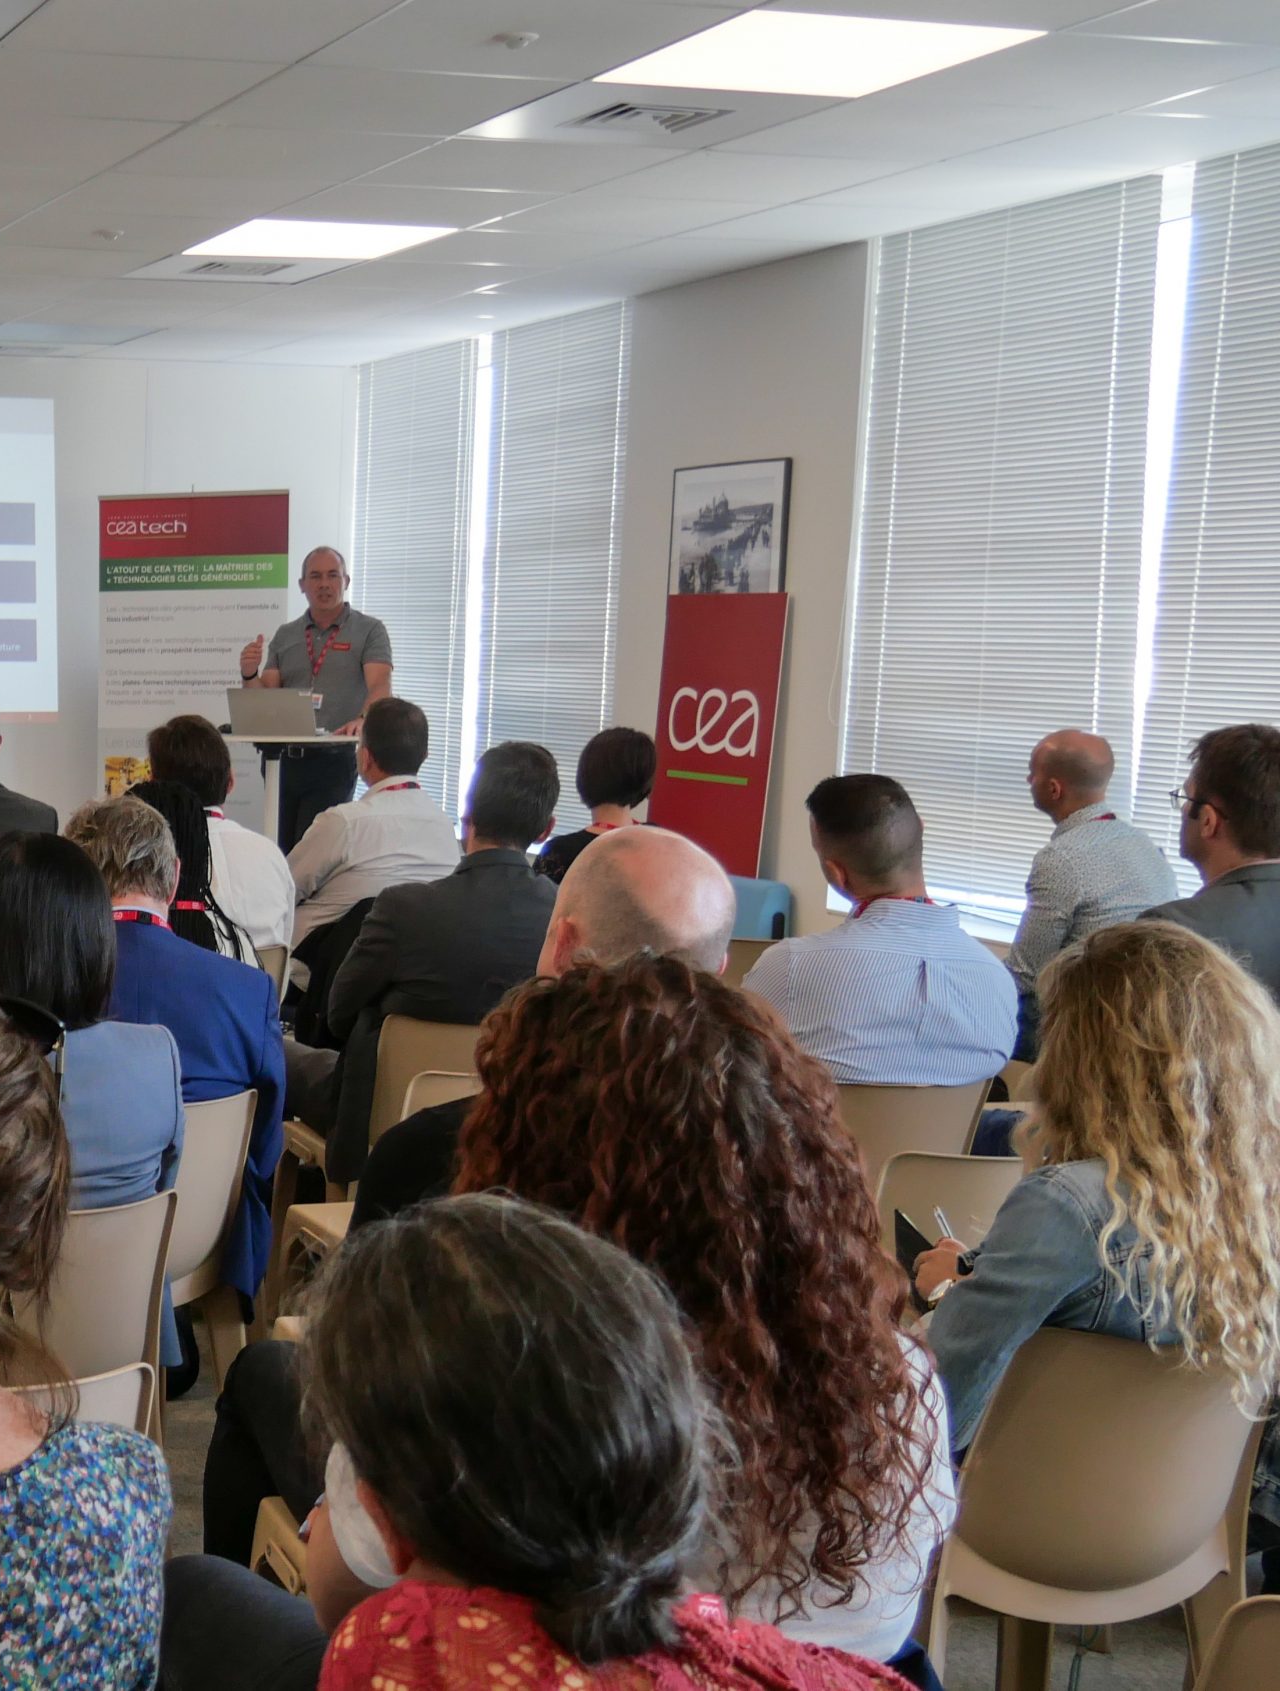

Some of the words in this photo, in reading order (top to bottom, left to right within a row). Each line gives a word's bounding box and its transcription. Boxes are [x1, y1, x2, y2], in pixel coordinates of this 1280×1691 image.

[106, 566, 139, 575] L'ATOUT
[140, 565, 153, 574] DE
[154, 565, 171, 574] CEA
[173, 564, 195, 573] TECH
[203, 564, 217, 572] LA
[218, 562, 255, 571] MAÎTRISE
[256, 562, 273, 571] DES
[113, 574, 176, 584] TECHNOLOGIES
[177, 573, 199, 583] CLÉS
[200, 572, 255, 582] GÉNÉRIQUES
[668, 686, 760, 758] cea
